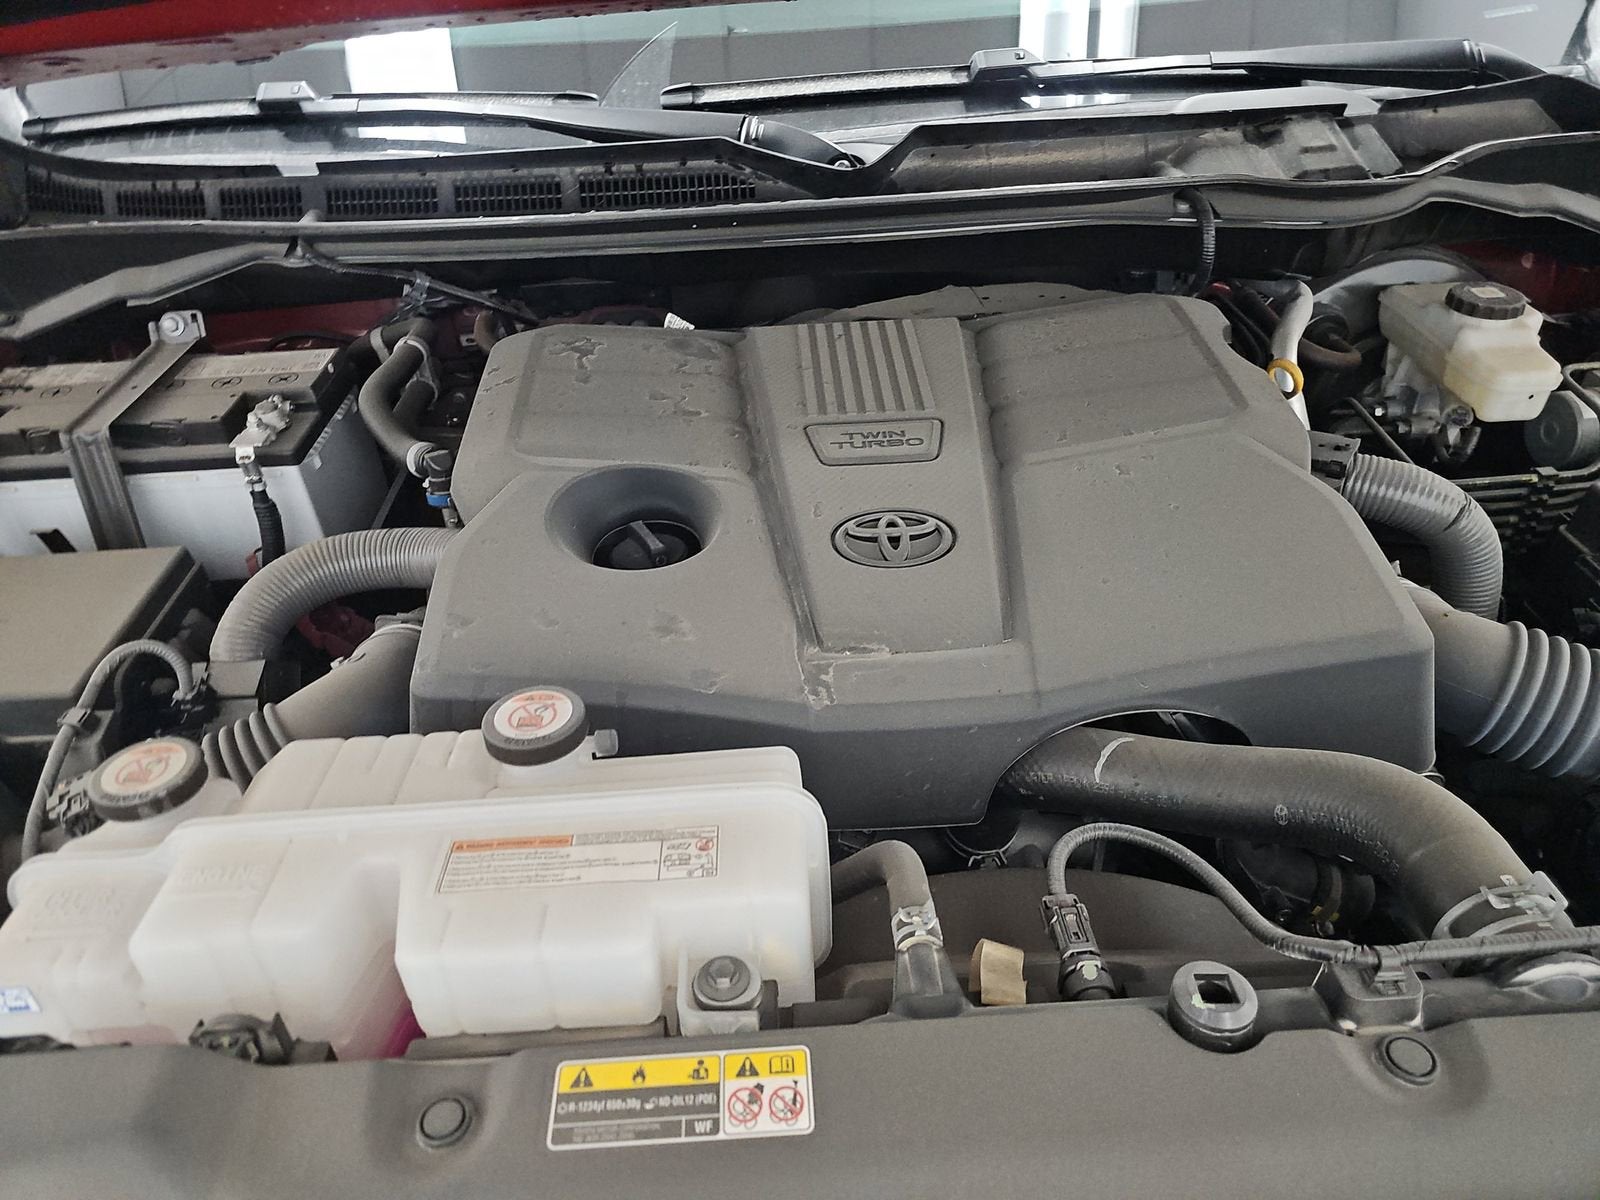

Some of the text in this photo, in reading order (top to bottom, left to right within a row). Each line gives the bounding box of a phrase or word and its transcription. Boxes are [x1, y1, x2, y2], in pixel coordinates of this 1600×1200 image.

[840, 430, 906, 441] TWIN
[829, 437, 925, 449] TURBO
[694, 1119, 714, 1134] WF
